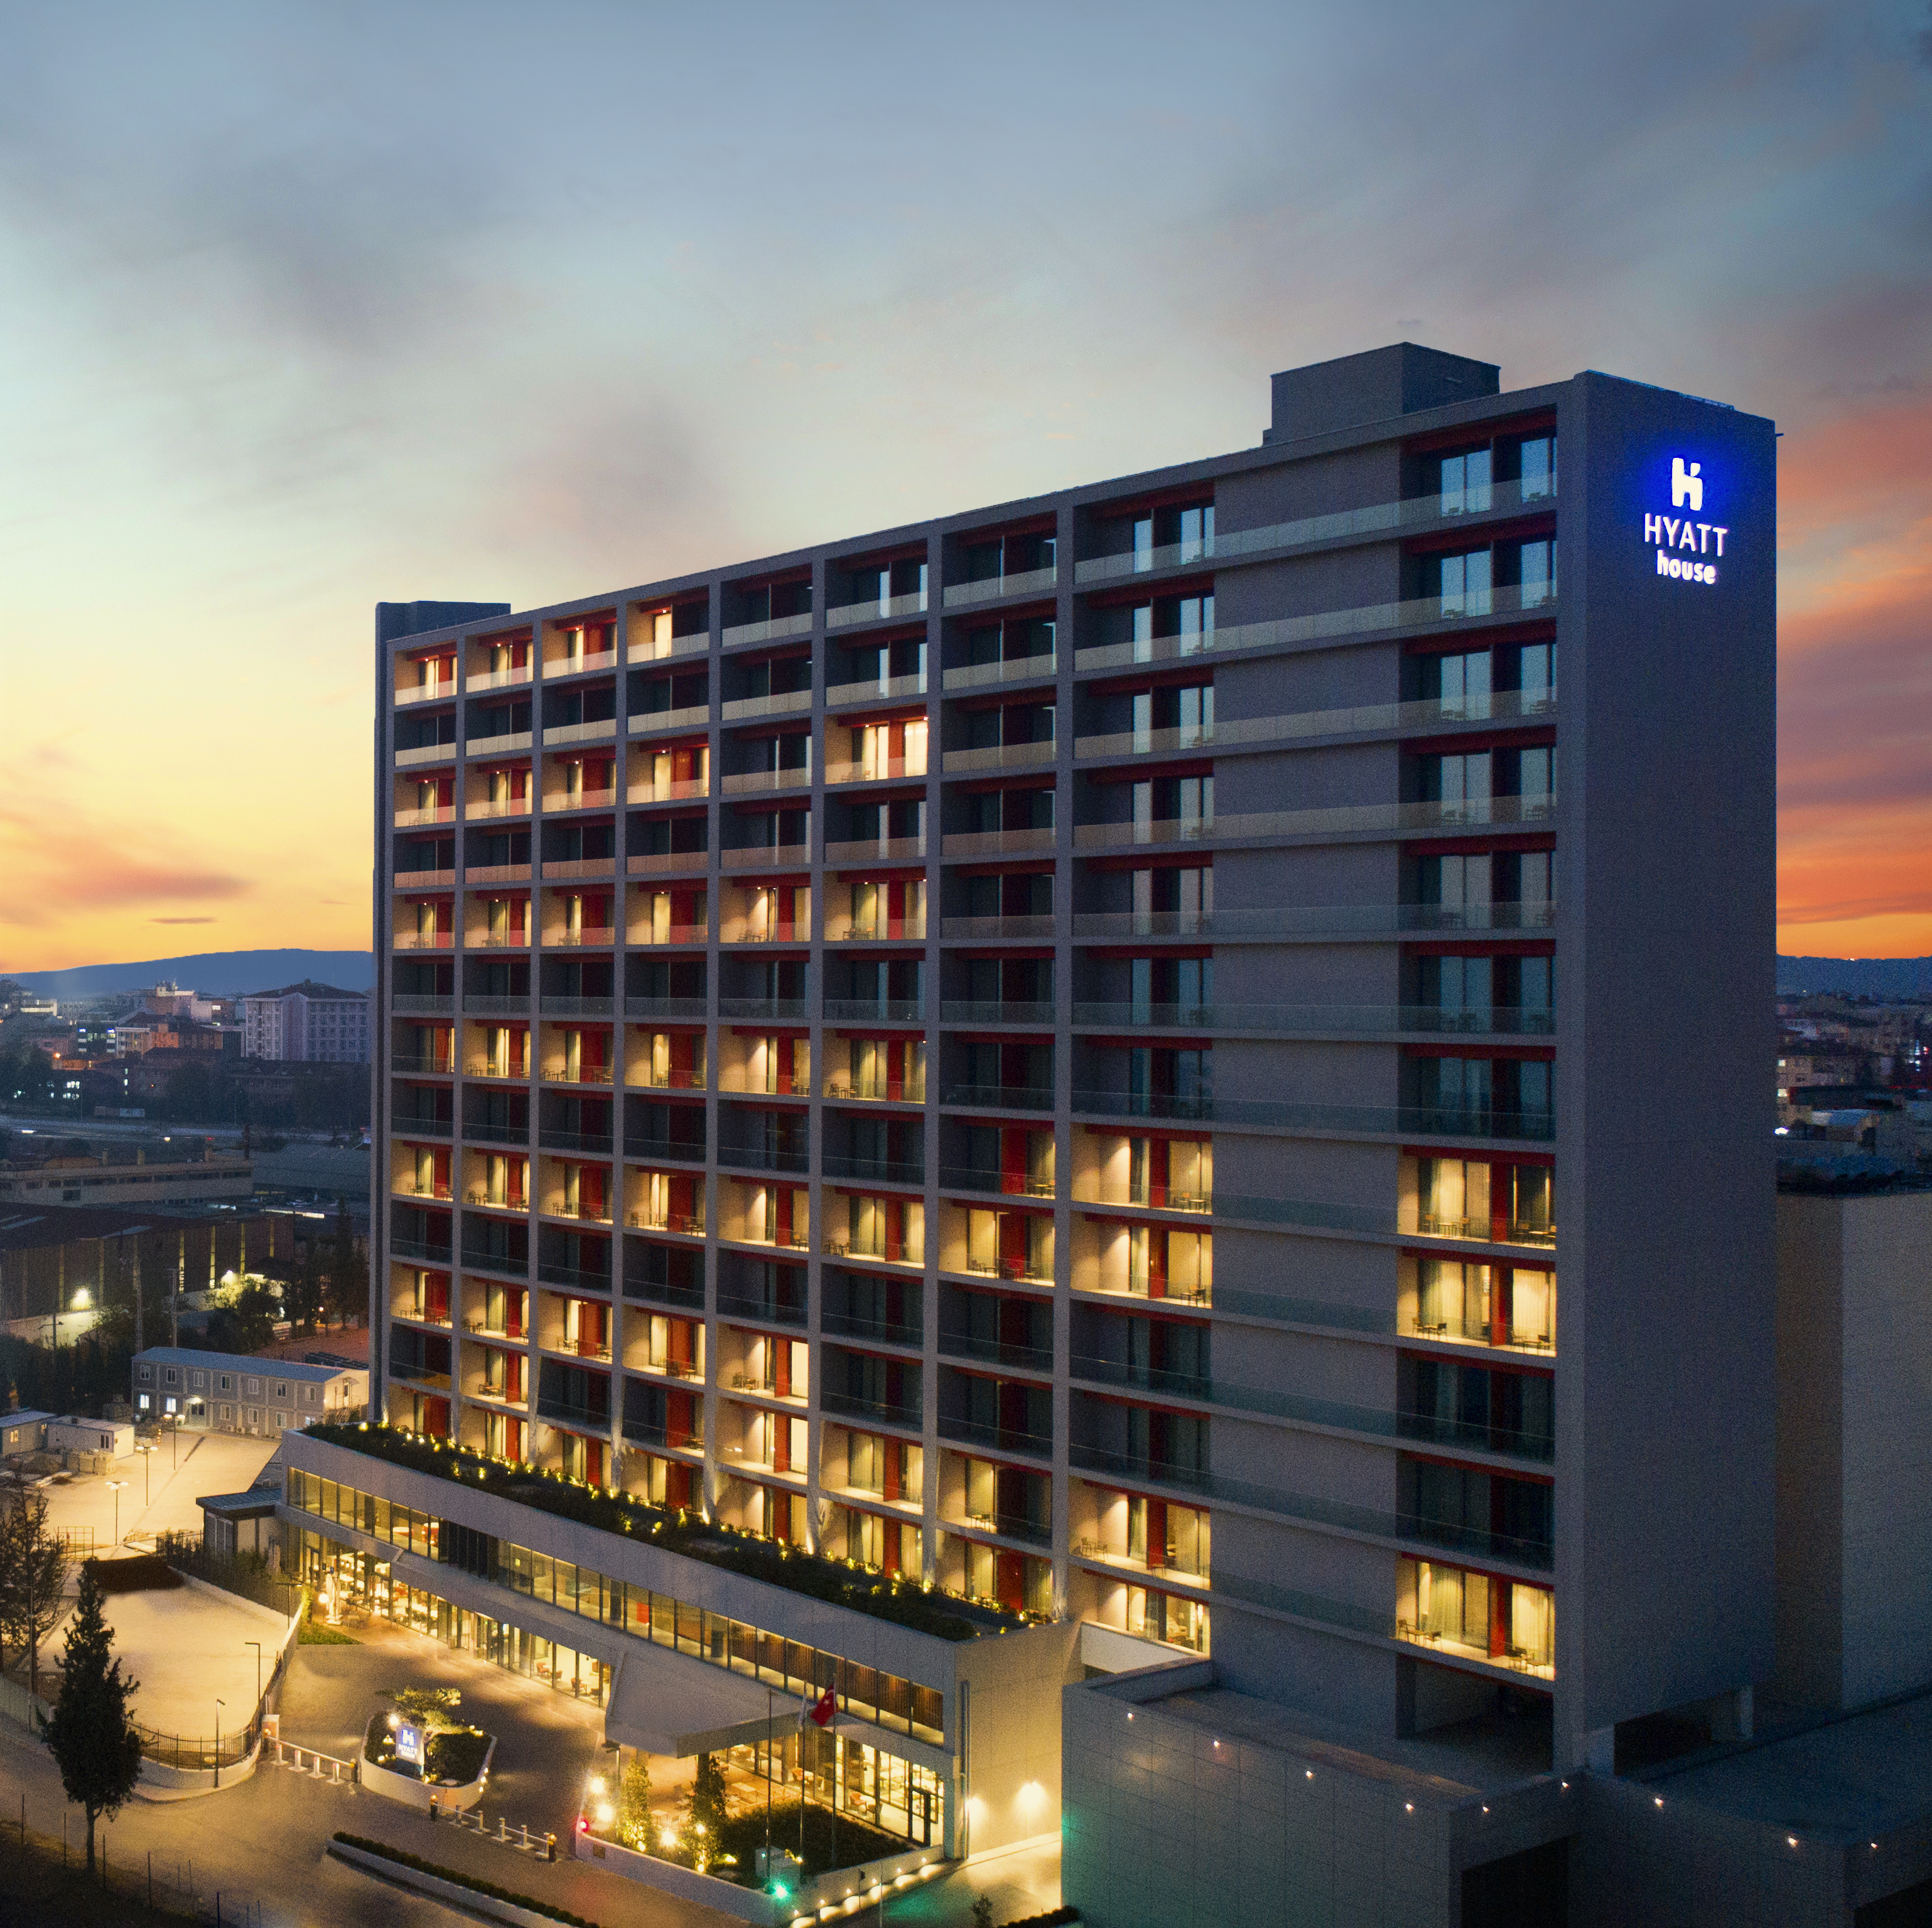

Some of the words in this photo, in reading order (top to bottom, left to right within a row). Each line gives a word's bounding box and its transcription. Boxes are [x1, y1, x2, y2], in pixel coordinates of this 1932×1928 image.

[1644, 512, 1728, 557] HYATT
[1657, 549, 1717, 585] house
[398, 1743, 418, 1755] HYATT
